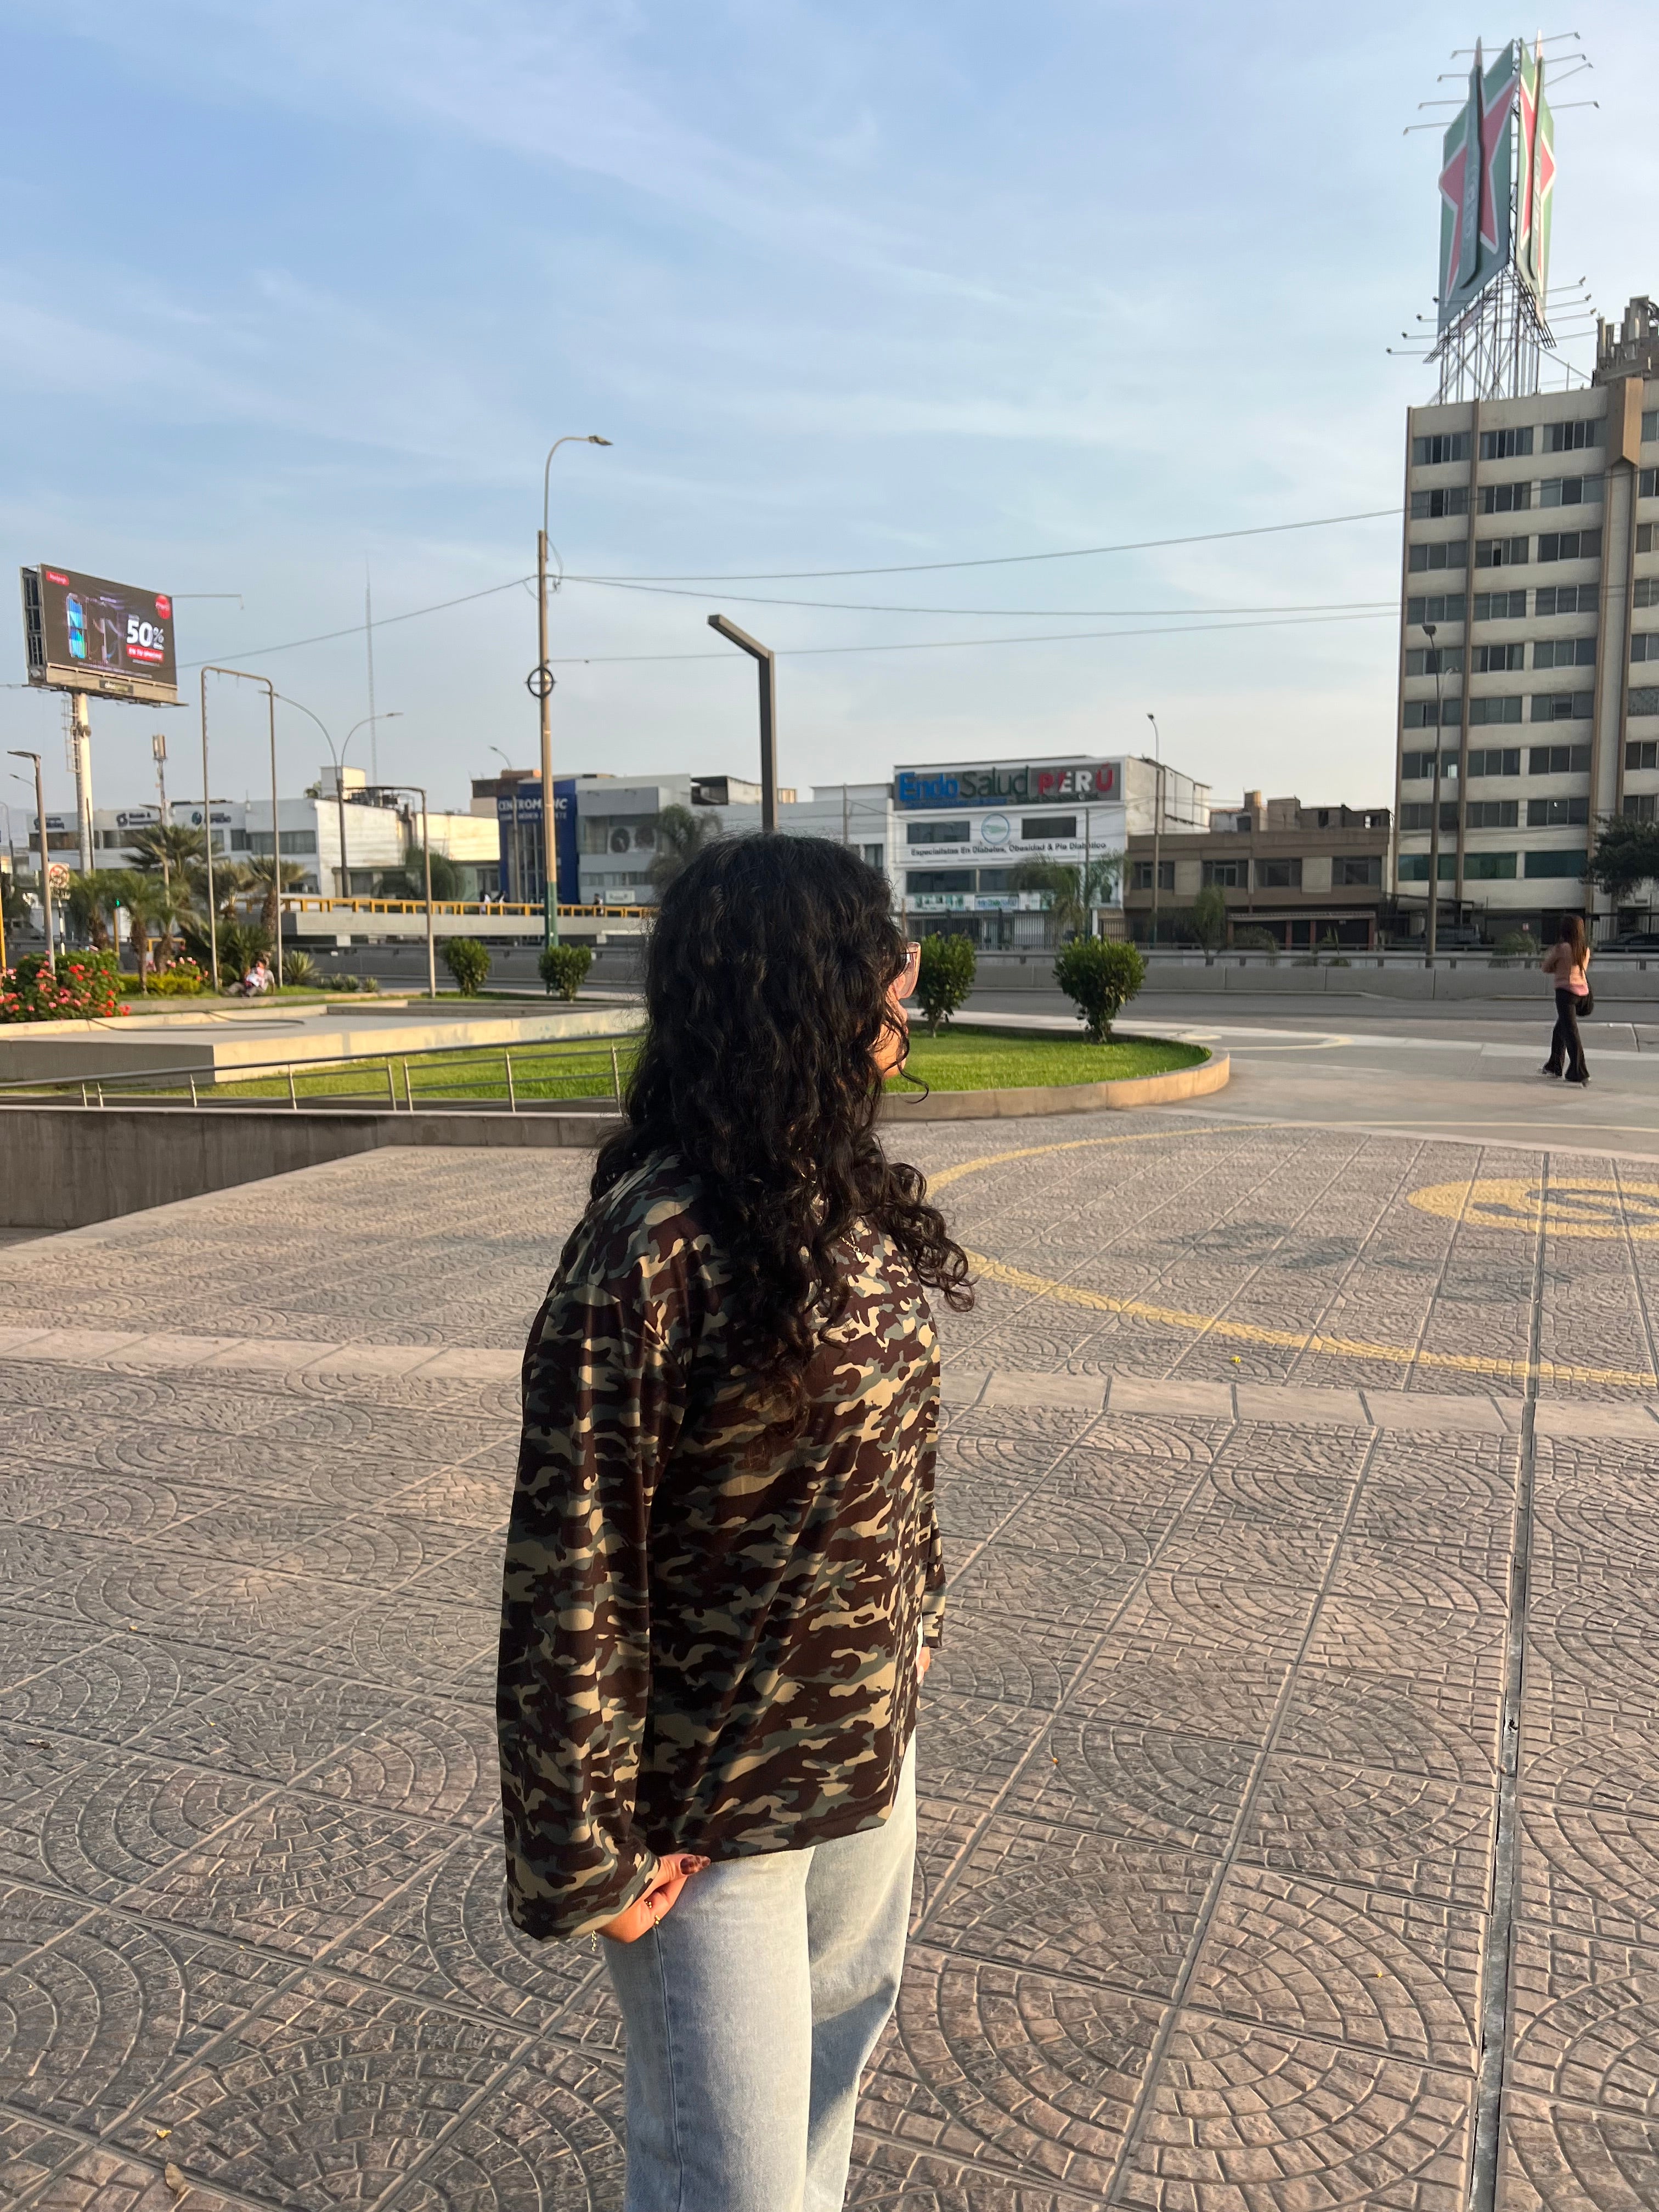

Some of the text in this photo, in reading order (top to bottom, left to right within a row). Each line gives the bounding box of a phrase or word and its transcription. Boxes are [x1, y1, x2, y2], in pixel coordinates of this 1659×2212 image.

[127, 620, 164, 647] 50%
[498, 798, 568, 812] CENROMIC
[911, 847, 958, 856] Especialistas
[1008, 843, 1045, 851] Obesidad
